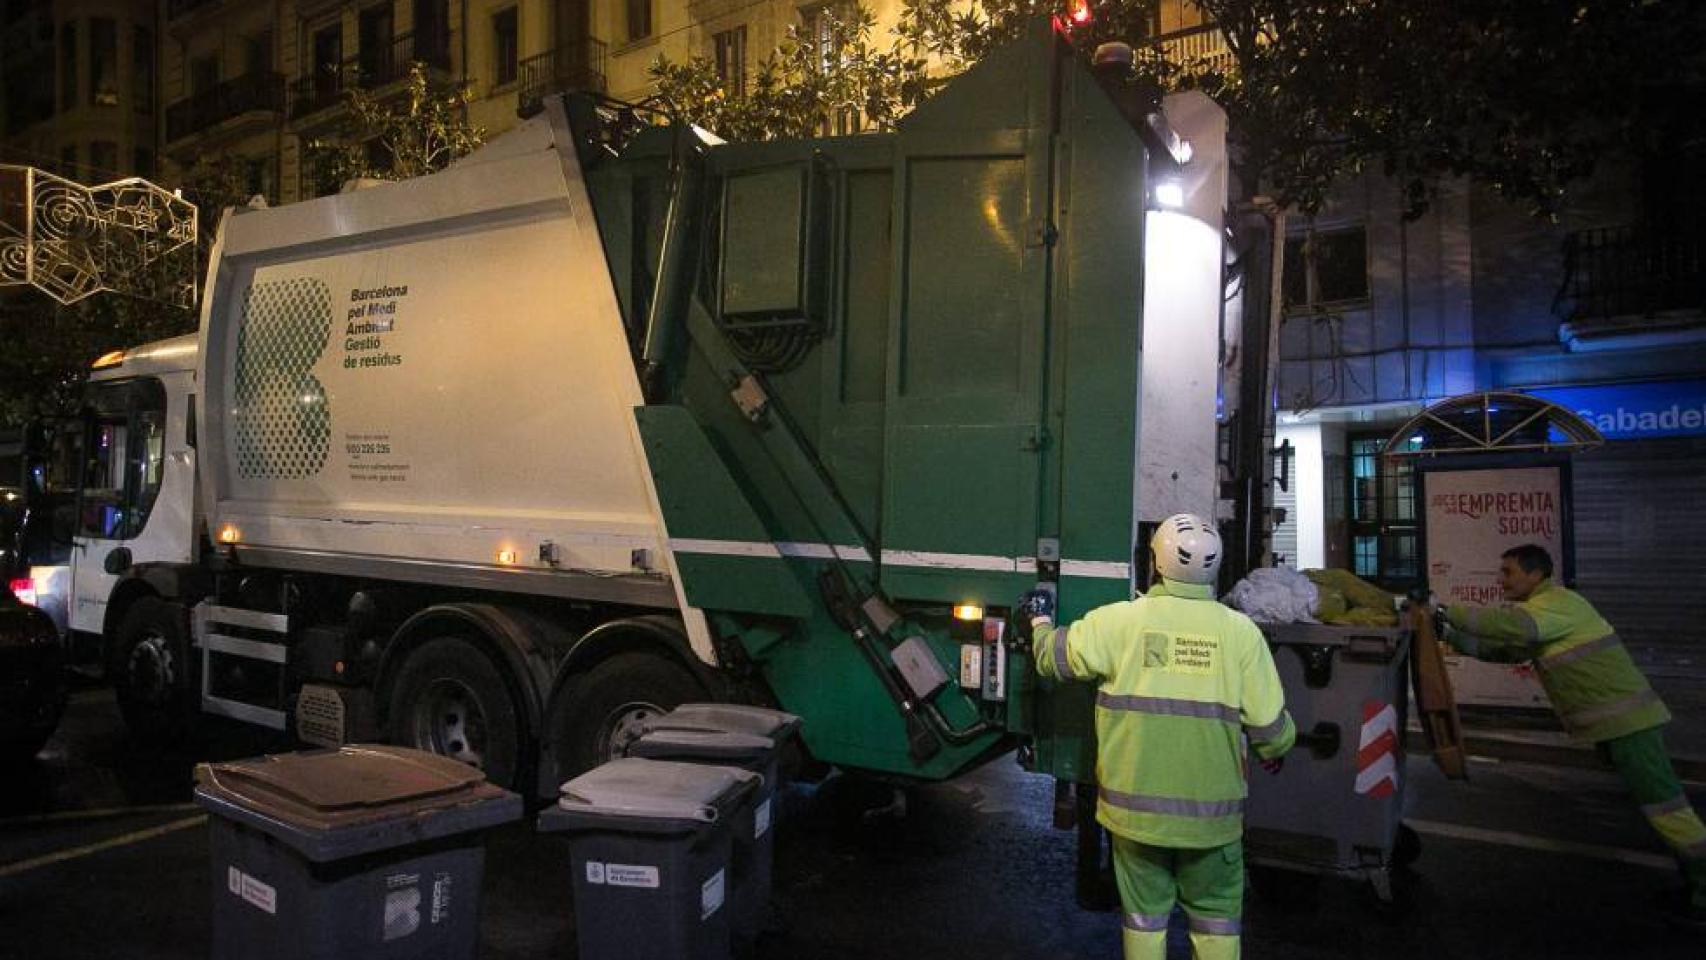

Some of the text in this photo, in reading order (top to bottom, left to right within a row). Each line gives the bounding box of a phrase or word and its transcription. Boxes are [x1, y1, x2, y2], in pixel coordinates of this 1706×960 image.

[351, 285, 408, 302] Barcelona
[368, 302, 396, 315] Medi
[344, 336, 380, 351] Gestió
[343, 353, 402, 368] de residus
[1458, 491, 1554, 519] EMPREMTA
[1498, 515, 1554, 539] SOCIAL
